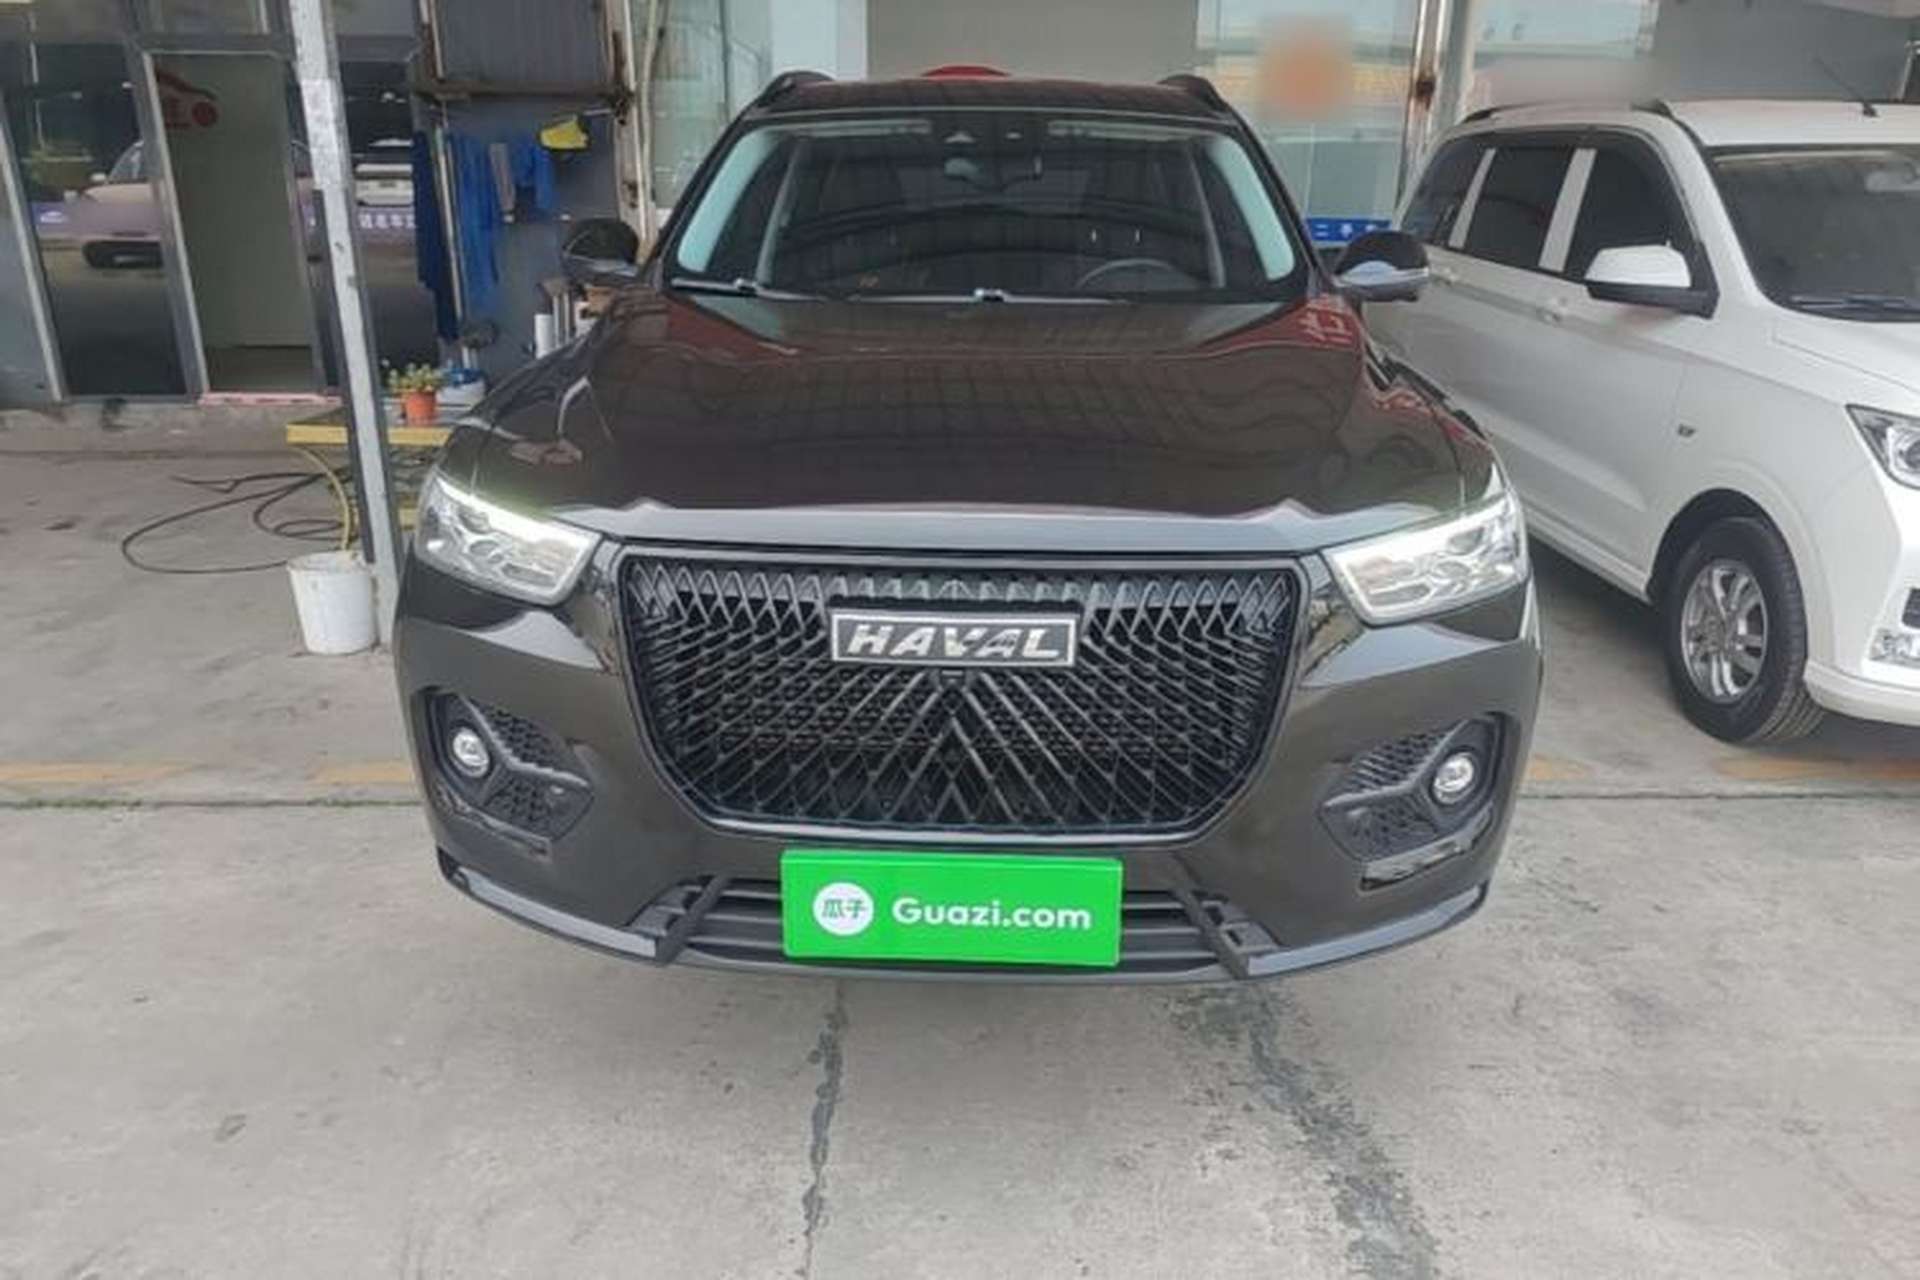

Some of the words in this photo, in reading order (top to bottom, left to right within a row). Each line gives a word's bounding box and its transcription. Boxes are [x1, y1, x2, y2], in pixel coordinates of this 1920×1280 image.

[846, 623, 1059, 658] HAVAL
[821, 898, 868, 921] 瓜子
[892, 898, 1091, 929] Guazi.com
